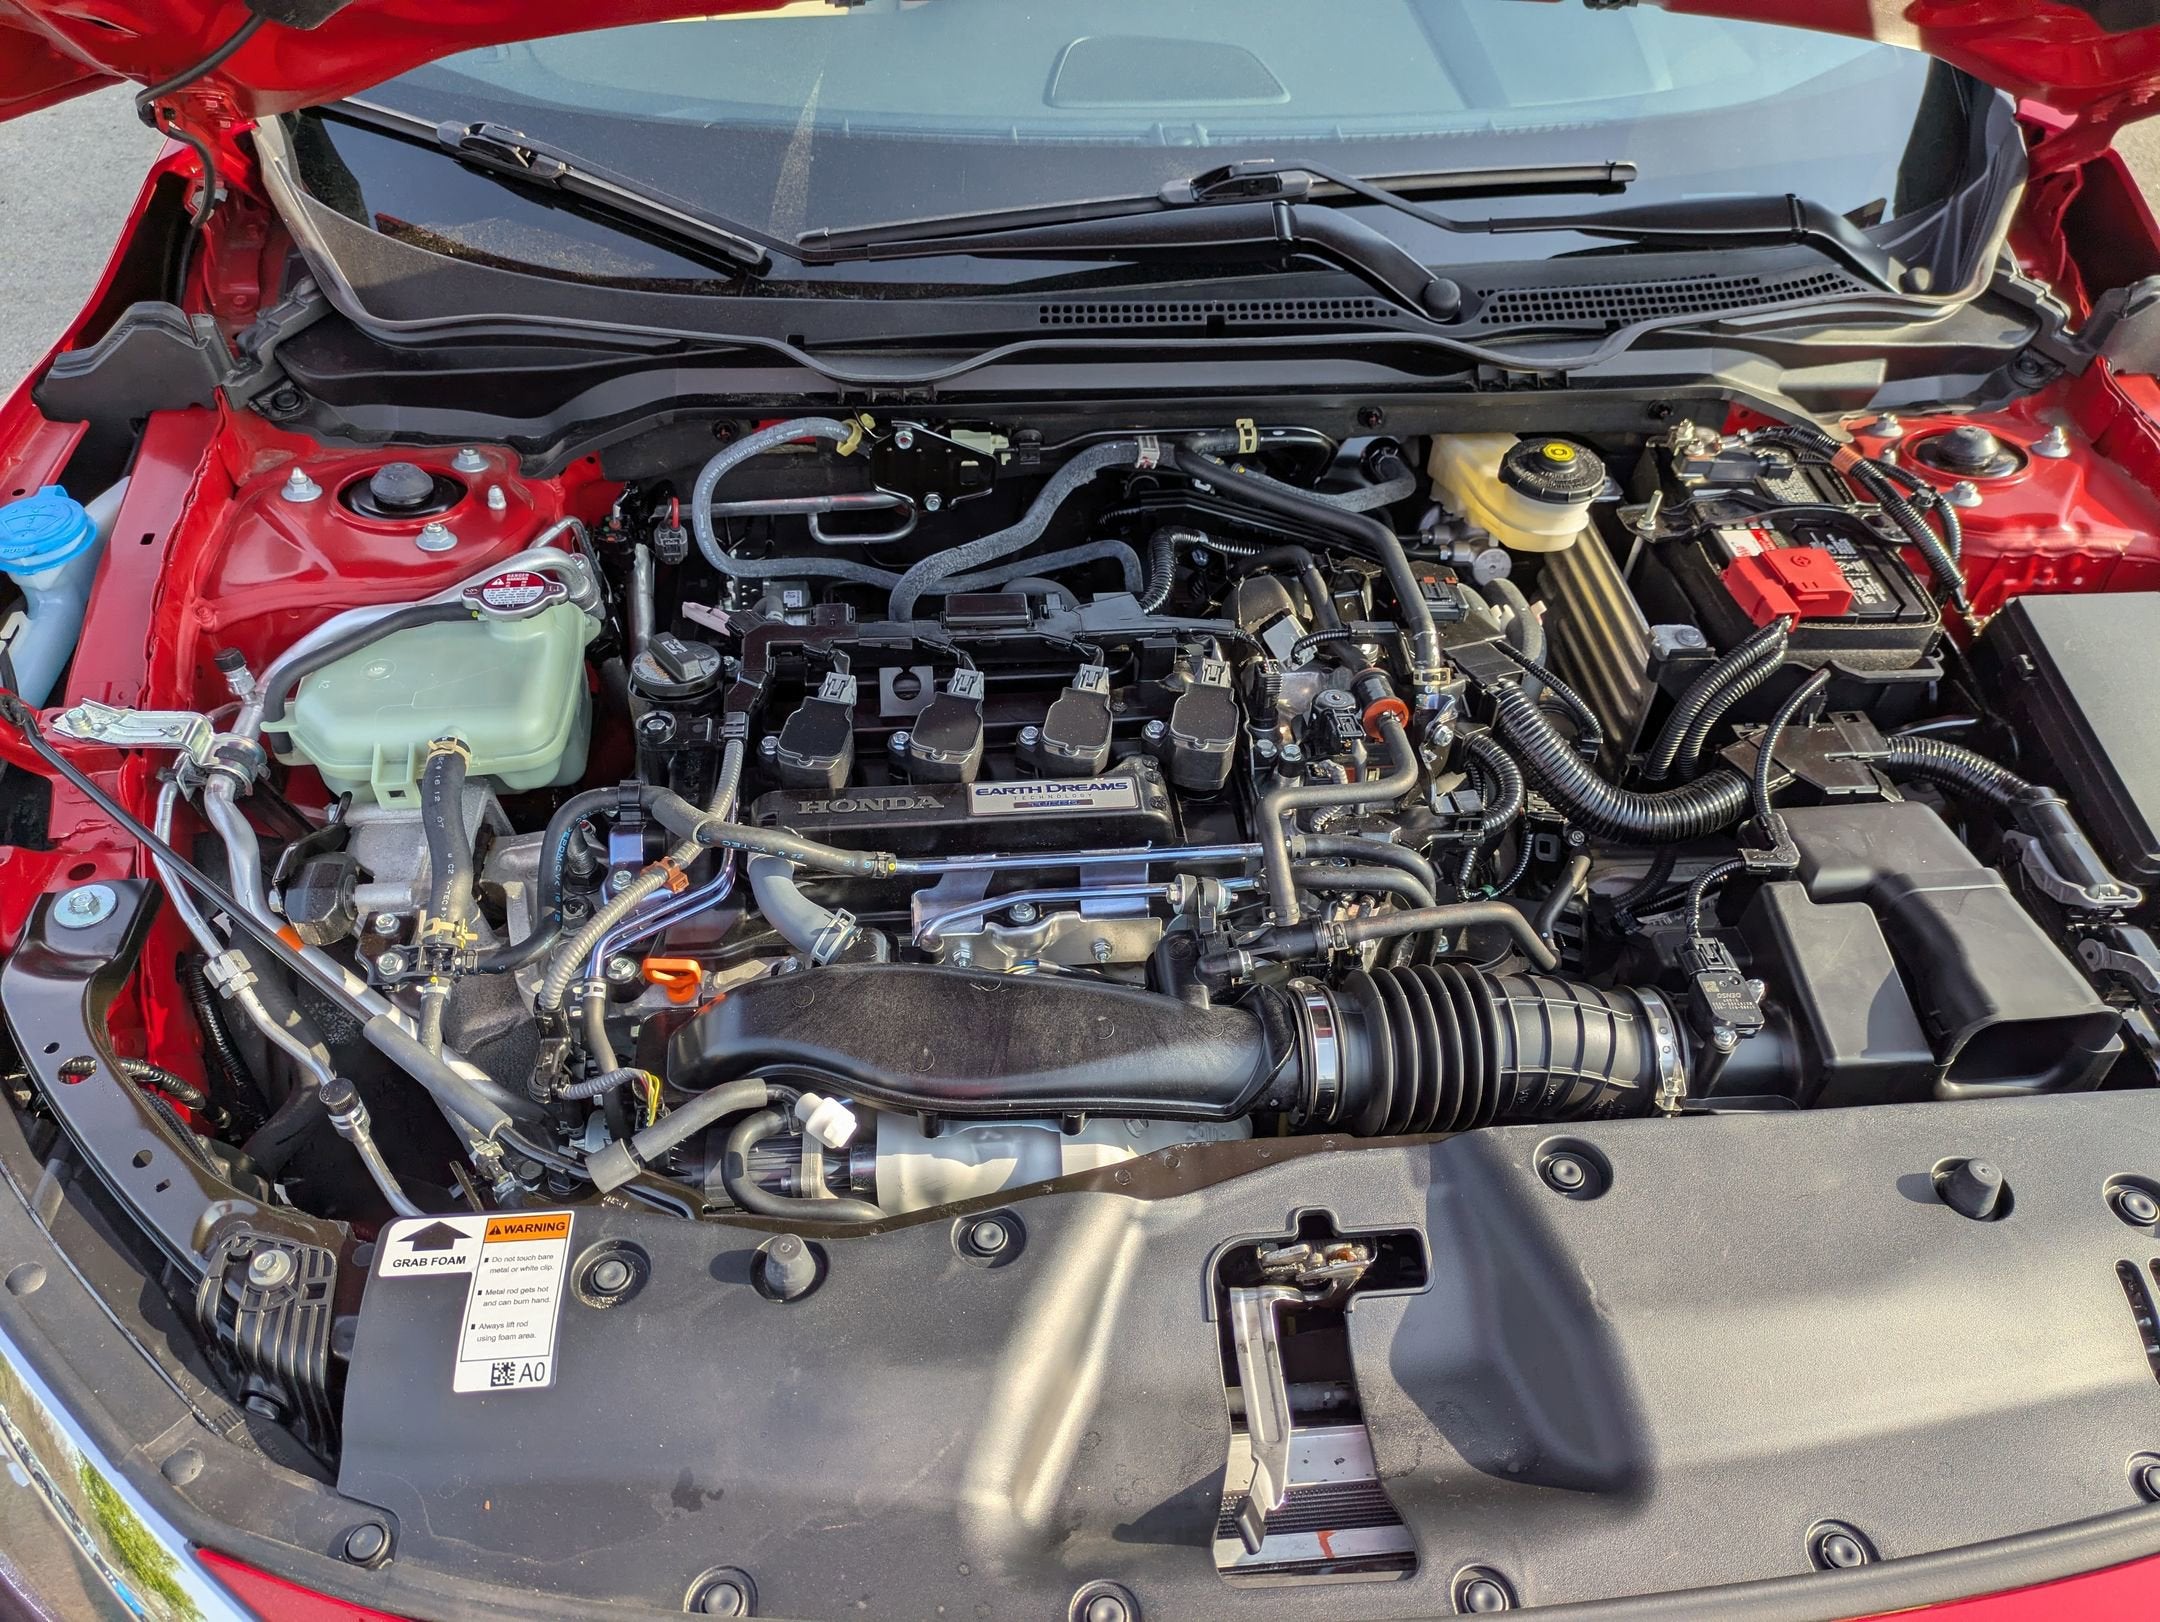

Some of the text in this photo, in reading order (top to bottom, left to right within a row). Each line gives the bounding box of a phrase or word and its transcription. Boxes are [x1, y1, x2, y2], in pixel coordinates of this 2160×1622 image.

[975, 782, 1128, 796] EARTH DREAMS
[797, 795, 945, 814] HONDA
[721, 840, 767, 853] Y-TEC
[447, 863, 455, 874] C2
[441, 879, 454, 905] Y-TEC
[504, 1221, 566, 1234] WARNING
[392, 1255, 466, 1268] GRAB FOAM
[520, 1287, 535, 1295] gets
[476, 1335, 496, 1343] using
[498, 1333, 516, 1341] foam
[518, 1361, 546, 1383] A0
